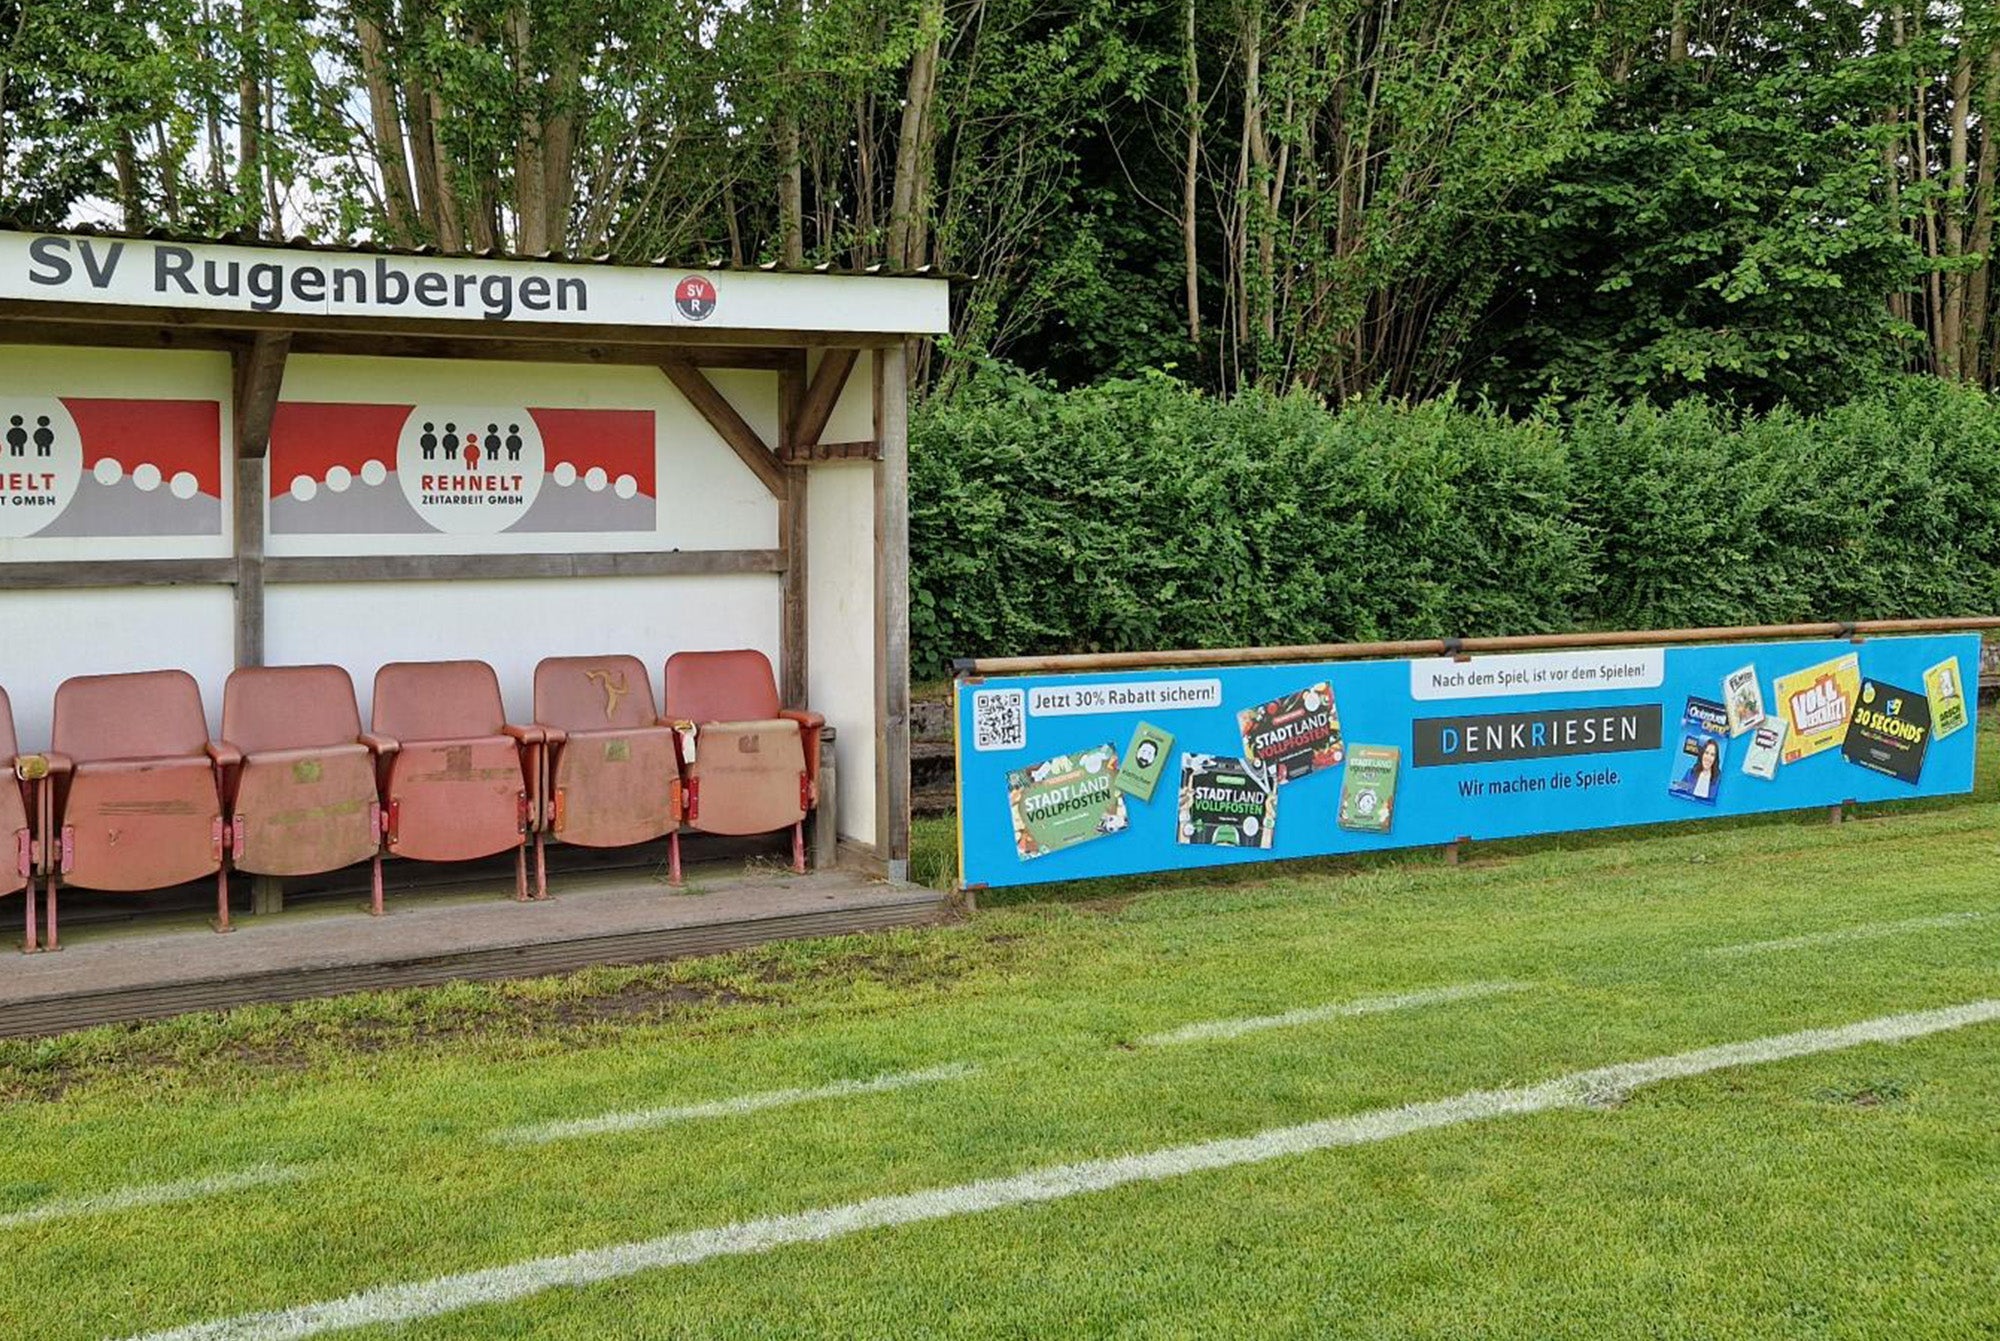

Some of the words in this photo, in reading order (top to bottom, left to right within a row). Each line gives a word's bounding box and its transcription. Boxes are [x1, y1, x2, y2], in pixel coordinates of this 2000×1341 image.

[29, 236, 125, 289] SV
[154, 245, 587, 321] Rugenbergen
[687, 283, 705, 298] SV
[691, 298, 701, 312] R
[421, 475, 523, 491] REHNELT
[12, 495, 56, 506] GMBH
[422, 495, 484, 505] ZEITARBEIT
[488, 495, 523, 505] GMBH
[1432, 673, 1465, 688] Nach
[1468, 671, 1495, 686] dem
[1497, 670, 1529, 688] Spiel,
[1533, 668, 1547, 682] ist
[1550, 668, 1568, 681] vor
[1571, 665, 1597, 680] dem
[1599, 663, 1646, 681] Spielen!
[1035, 694, 1071, 709] Jetzt
[1074, 691, 1105, 706] 30%
[1108, 688, 1156, 705] Rabatt
[1160, 685, 1215, 702] sichern!
[1255, 723, 1294, 750] STADT
[1293, 712, 1328, 735] LAND
[1442, 716, 1637, 754] DENKRIESEN
[1854, 707, 1871, 726] 30
[1869, 713, 1925, 743] SECONDS
[1258, 726, 1330, 759] VOLLPFOSTEN
[1458, 780, 1483, 796] Wir
[1488, 774, 1546, 795] machen
[1550, 771, 1572, 790] die
[1576, 767, 1621, 789] Spiele.
[1023, 785, 1070, 813] STADT
[1070, 776, 1110, 800] LAND
[1026, 788, 1112, 824] VOLLPFOSTEN
[1195, 786, 1233, 801] STADT
[1233, 789, 1264, 805] LAND
[1195, 800, 1263, 815] VOLLPFOSTEN
